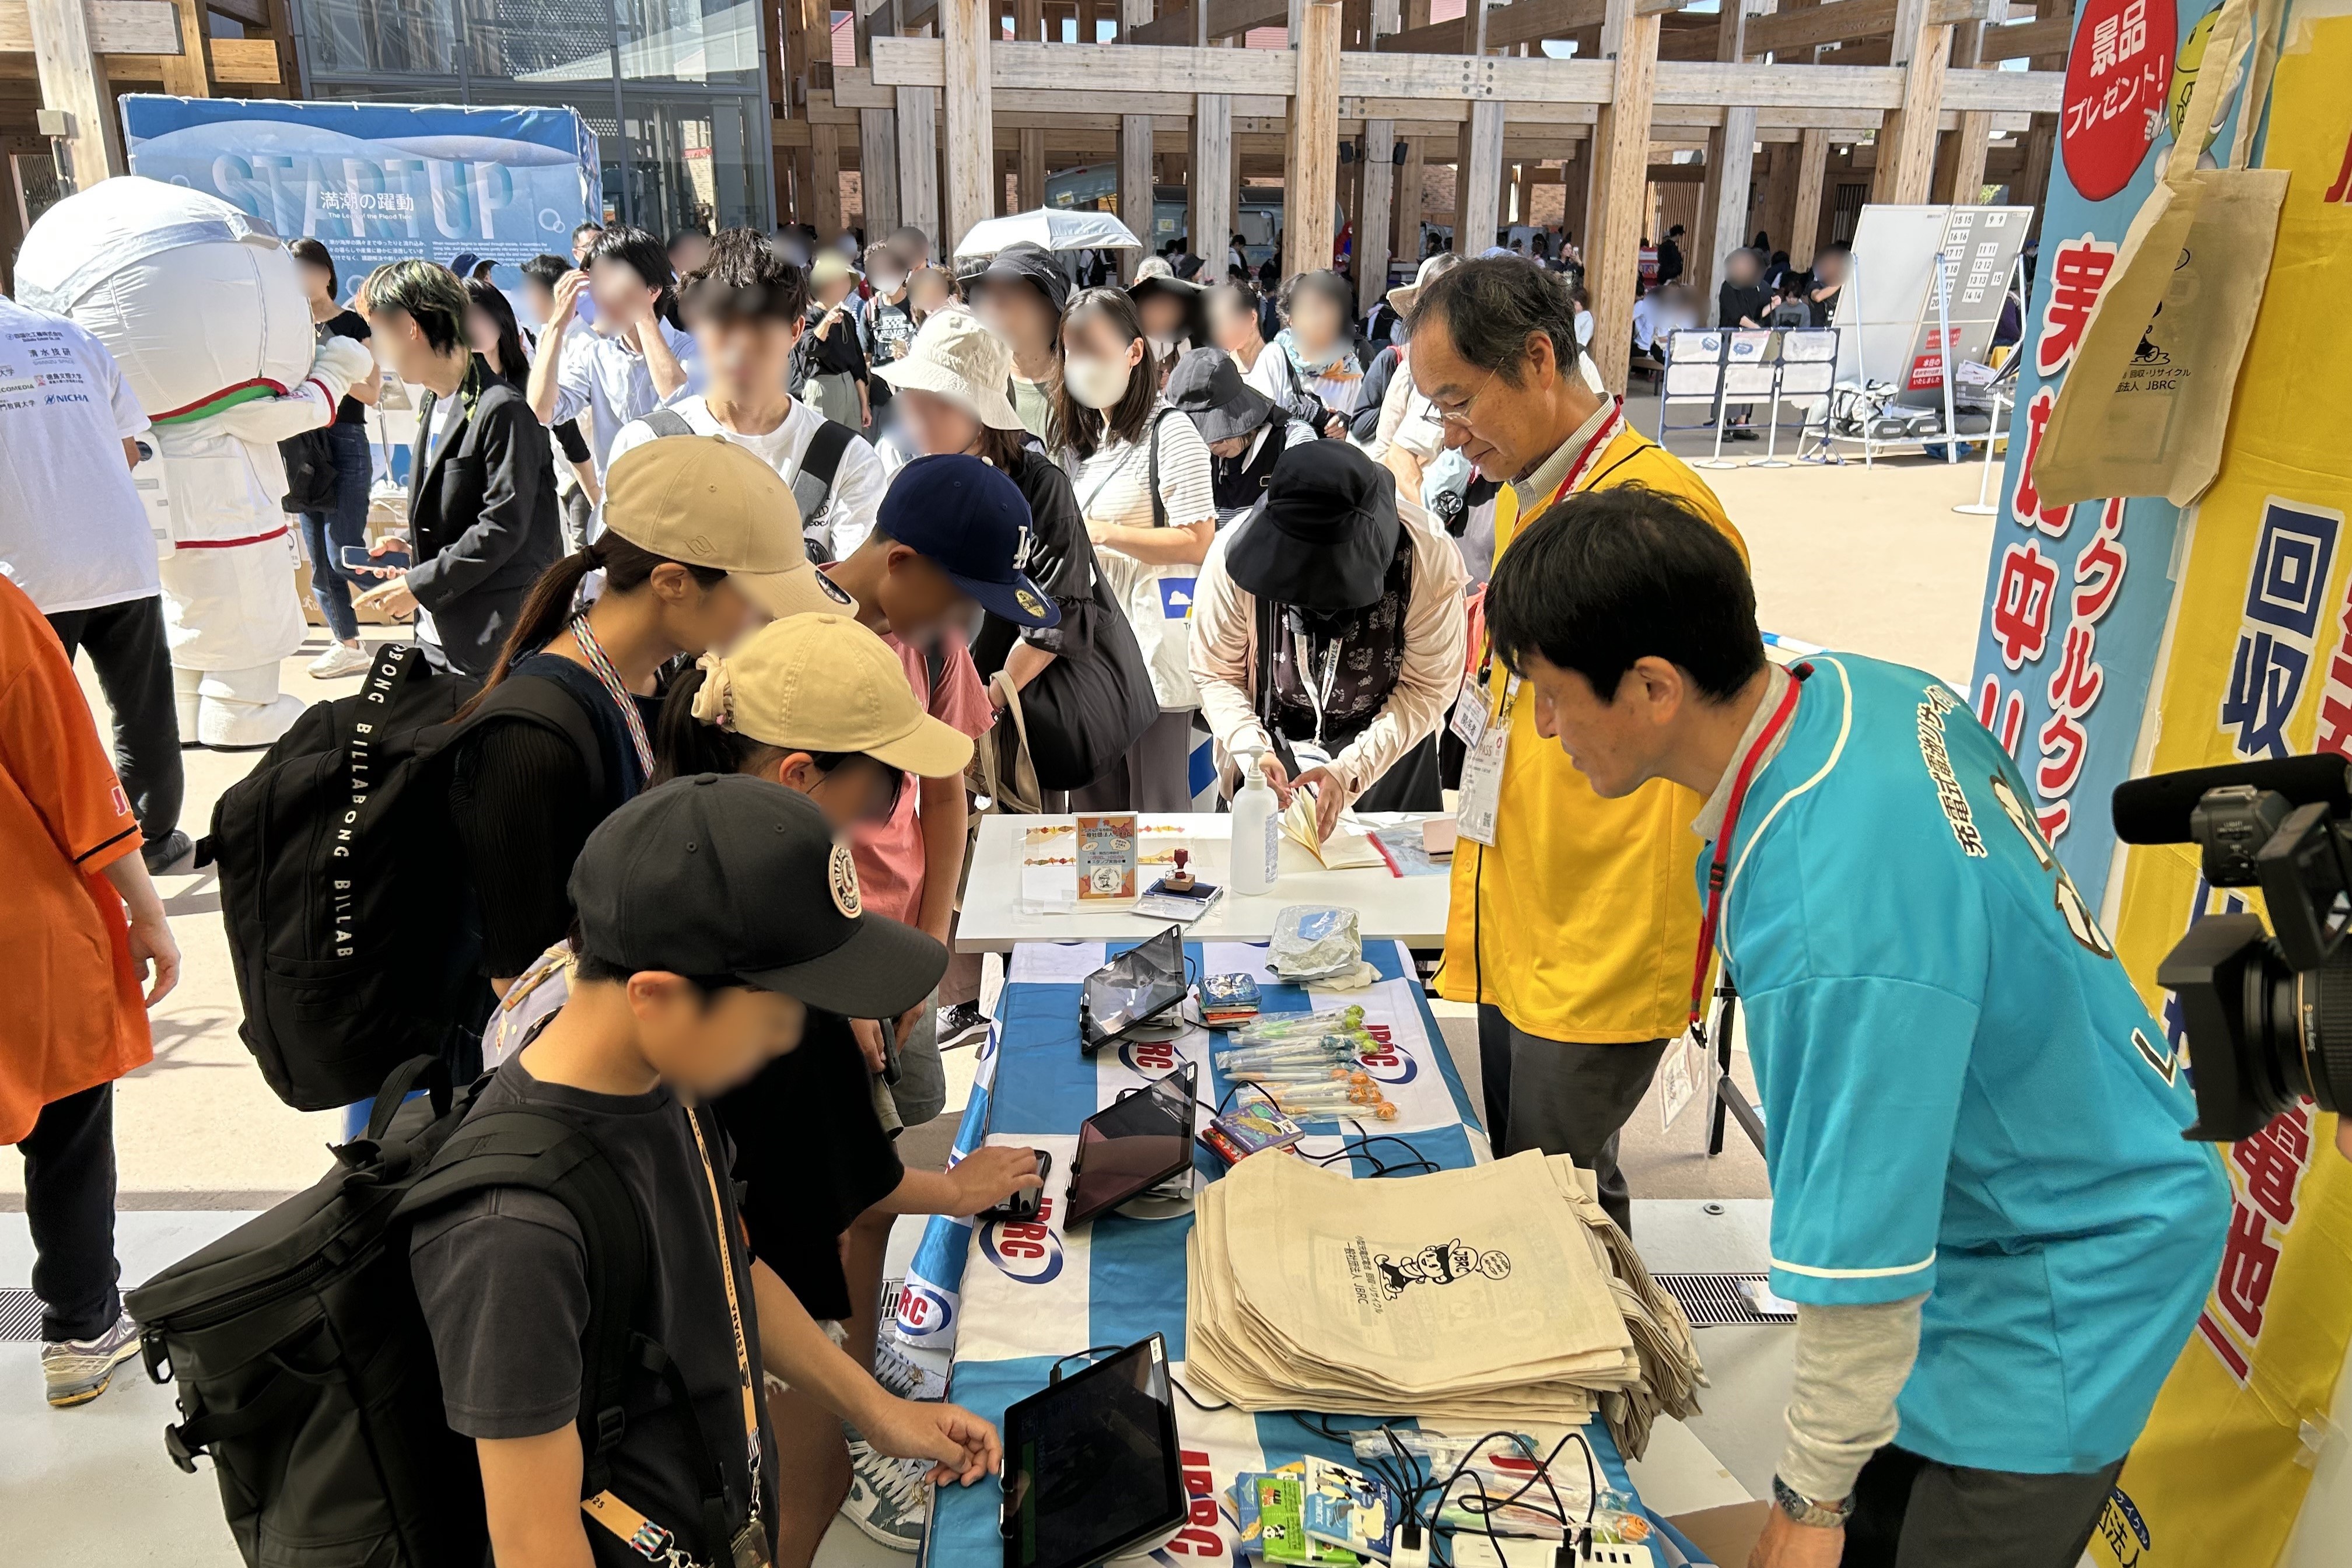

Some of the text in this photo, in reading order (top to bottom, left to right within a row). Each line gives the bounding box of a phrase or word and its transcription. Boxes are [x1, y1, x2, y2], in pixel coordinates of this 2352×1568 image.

[2090, 0, 2146, 78] 景品
[320, 191, 414, 211] 満潮の躍動
[1990, 216, 2003, 224] 9 9
[2146, 380, 2176, 390] JBRC
[334, 723, 372, 858] BILLABONG
[334, 880, 354, 957] BILLAB
[1136, 1042, 1173, 1069] RC
[1453, 1251, 1470, 1272] JBRC
[1354, 1283, 1368, 1304] JBRC
[2116, 1490, 2148, 1544] サイクル
